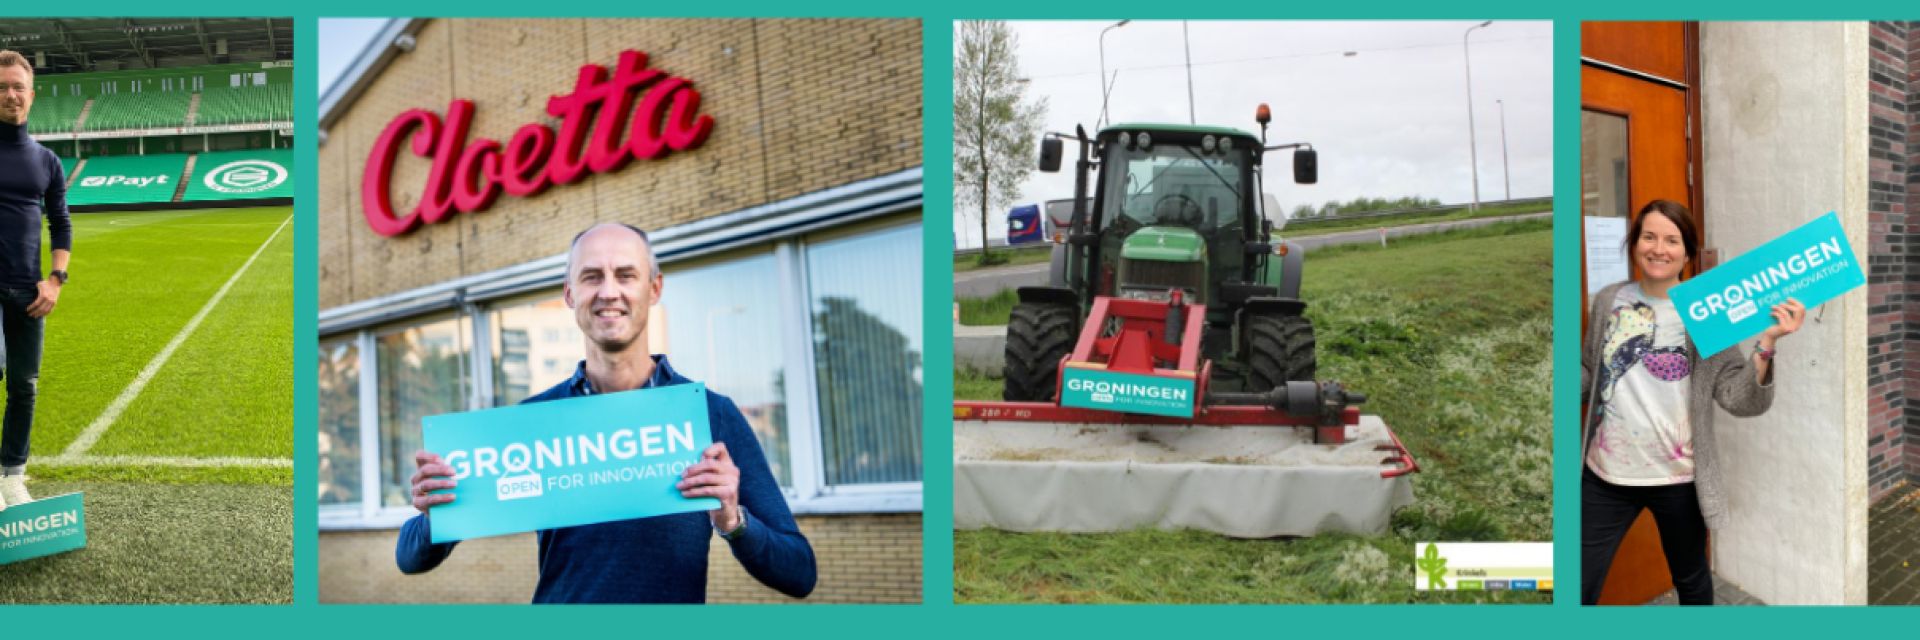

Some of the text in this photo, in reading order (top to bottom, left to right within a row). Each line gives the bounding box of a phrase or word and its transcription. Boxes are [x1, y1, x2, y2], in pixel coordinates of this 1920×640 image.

[362, 49, 714, 238] Cloetta
[106, 174, 170, 188] Payt
[1689, 236, 1843, 321] GRONINGEN
[1757, 291, 1782, 308] FOR
[1782, 259, 1850, 295] INNOVATION
[1067, 378, 1187, 401] GRONINGEN
[445, 421, 695, 481] GRONINGEN
[499, 480, 540, 495] OPEN
[547, 474, 584, 491] FOR
[2, 539, 22, 550] FOR
